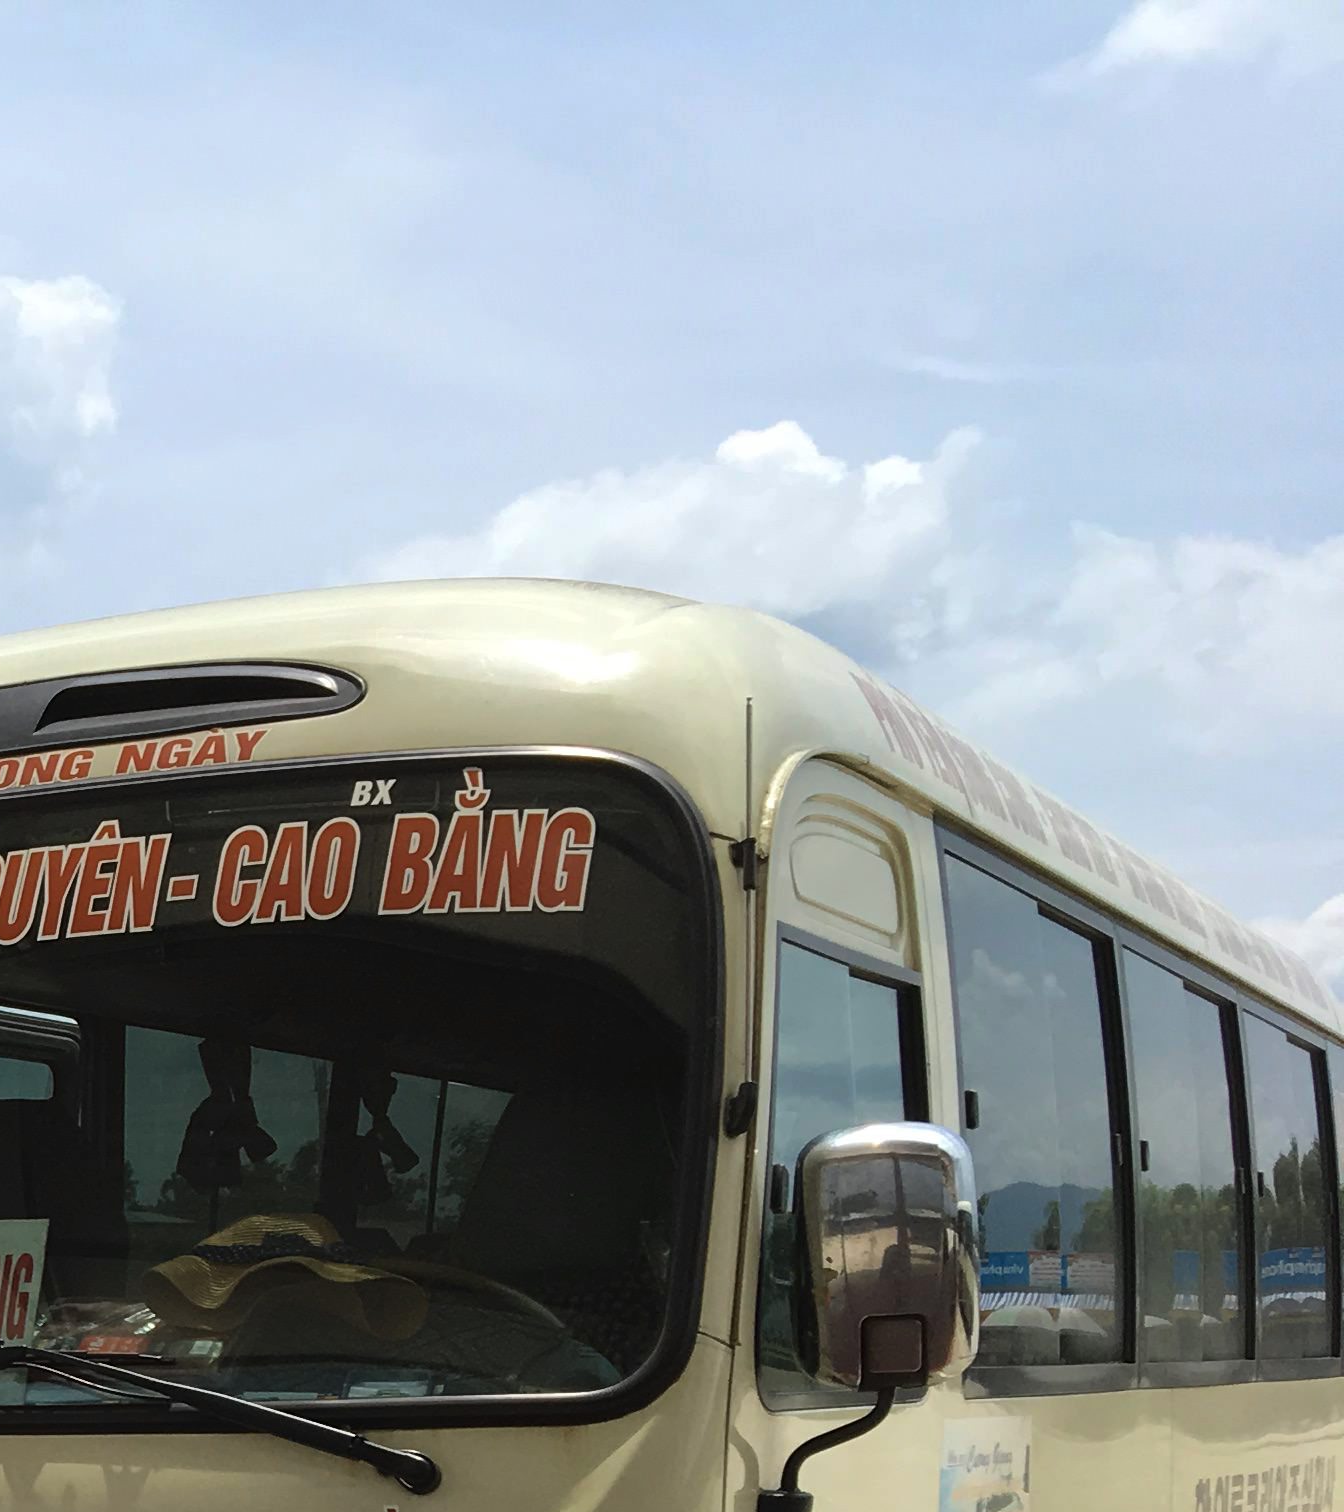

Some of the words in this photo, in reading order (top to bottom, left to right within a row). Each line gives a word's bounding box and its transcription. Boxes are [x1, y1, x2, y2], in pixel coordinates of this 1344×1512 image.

[115, 726, 269, 774] NGÀY
[350, 778, 396, 807] BX
[213, 816, 360, 929] CAO
[377, 766, 596, 917] BẰNG
